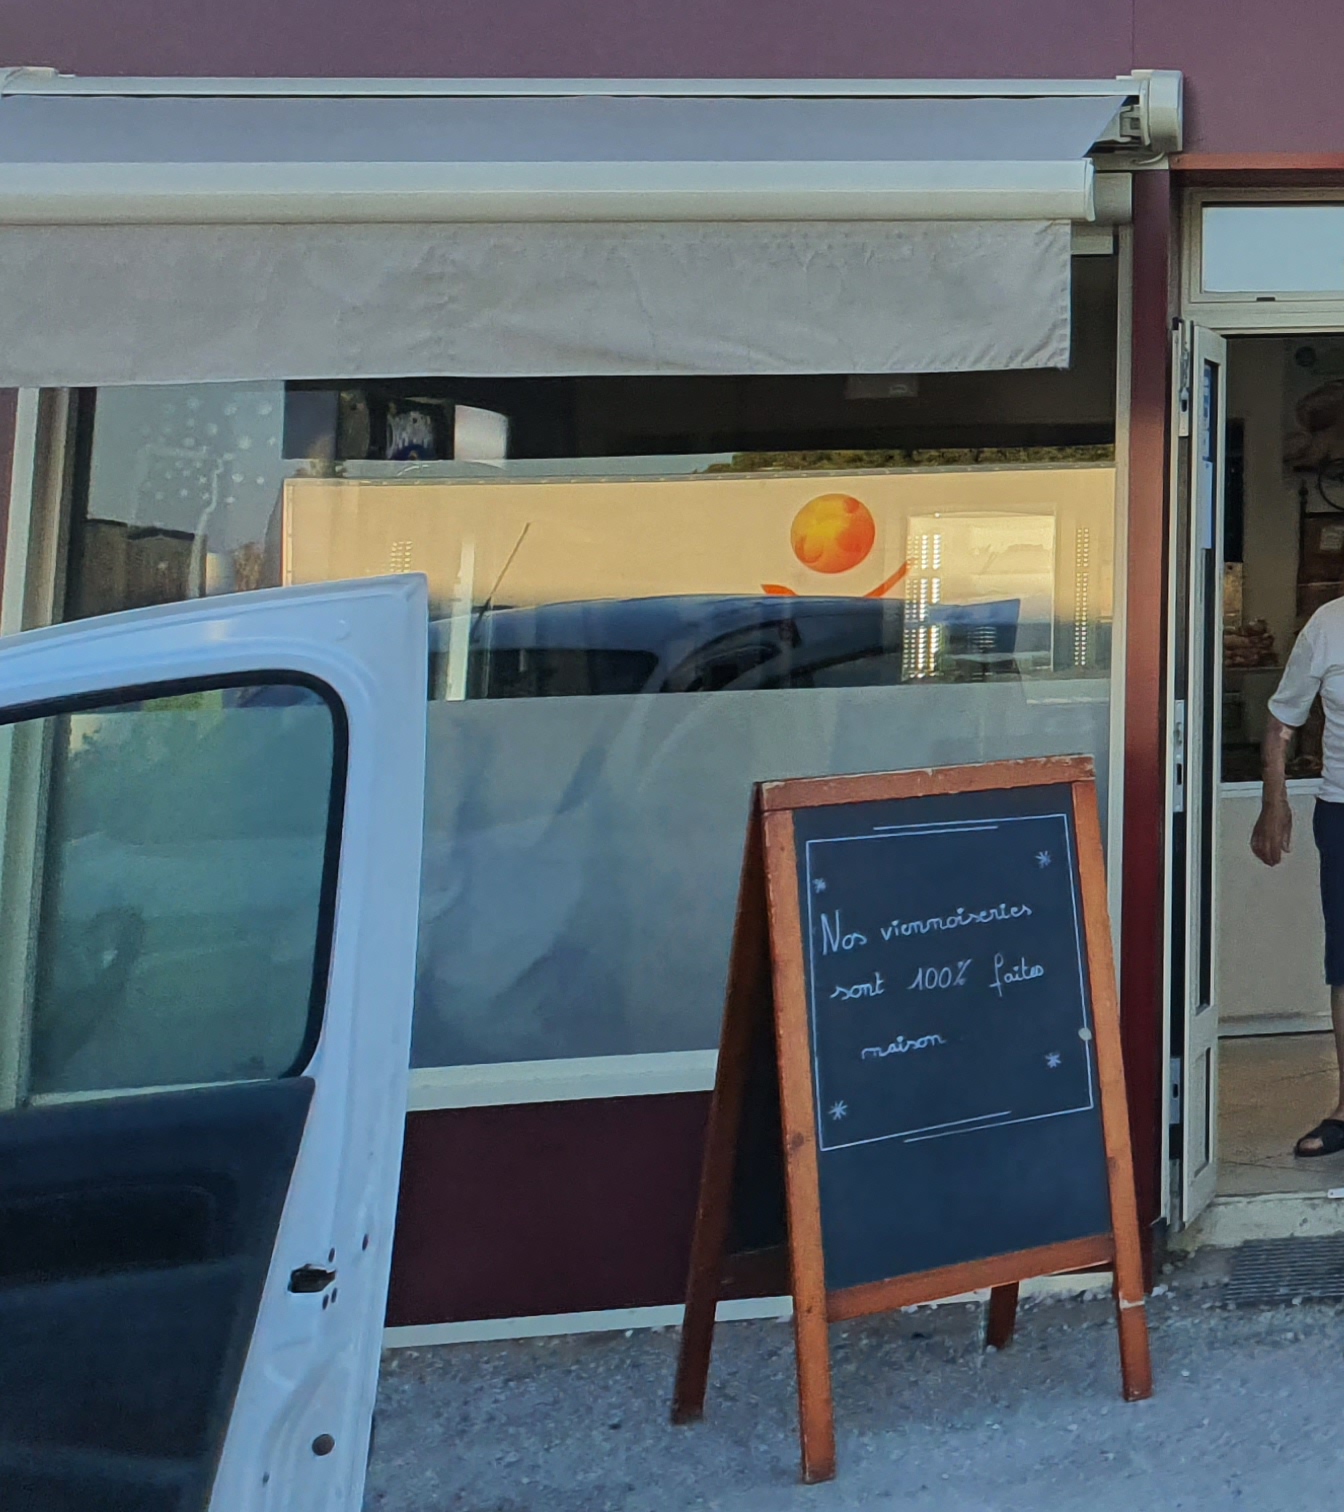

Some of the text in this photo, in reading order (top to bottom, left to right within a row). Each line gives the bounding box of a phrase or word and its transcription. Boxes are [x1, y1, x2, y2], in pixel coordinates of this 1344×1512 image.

[820, 903, 1033, 955] Nos viennoiseries
[829, 952, 1045, 1001] sont 100% faites
[861, 1034, 946, 1060] maison
